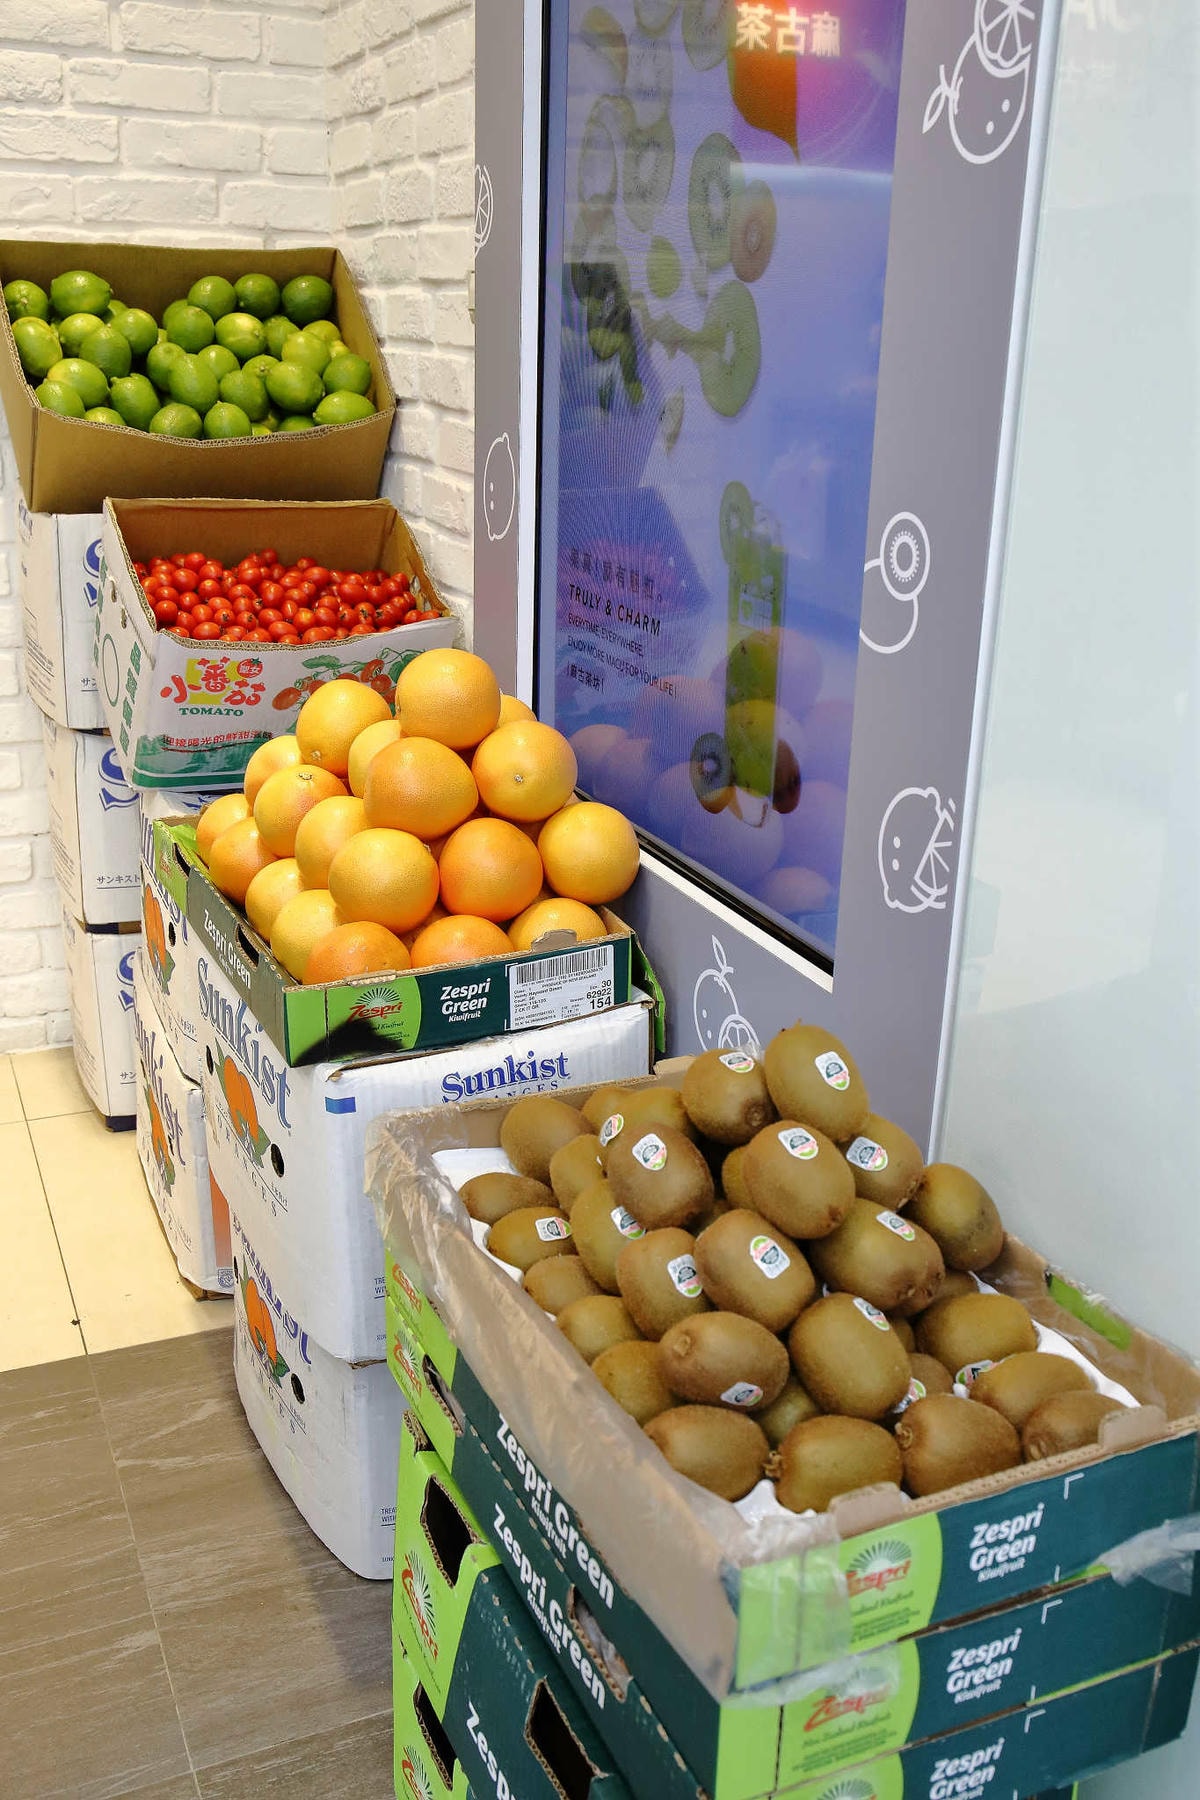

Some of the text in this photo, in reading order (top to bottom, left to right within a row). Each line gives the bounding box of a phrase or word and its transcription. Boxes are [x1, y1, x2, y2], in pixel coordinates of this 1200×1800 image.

[569, 583, 661, 637] TRULY & CHARM
[179, 707, 244, 717] TOMATO
[203, 908, 228, 956] Zespri
[228, 941, 251, 990] Green
[440, 977, 491, 1001] Zespri
[441, 996, 488, 1016] Green
[586, 988, 612, 999] 62922
[589, 996, 612, 1010] 154
[601, 979, 612, 988] 30
[448, 1010, 481, 1023] Kiwifruit
[198, 956, 293, 1131] Sunkist
[441, 1050, 570, 1103] Sunkist
[496, 1412, 552, 1514] Zespri
[531, 1495, 567, 1560] Kiwifruit
[969, 1502, 1045, 1549] Zespri
[493, 1502, 547, 1608] Zespri
[554, 1501, 615, 1610] Green
[969, 1534, 1036, 1571] Green
[977, 1556, 1026, 1583] Kiwifruit
[549, 1598, 605, 1710] Green
[946, 1627, 1022, 1673] Zespri
[946, 1657, 1013, 1694] Green
[929, 1736, 1006, 1783] Zespri
[929, 1765, 996, 1800] Green
